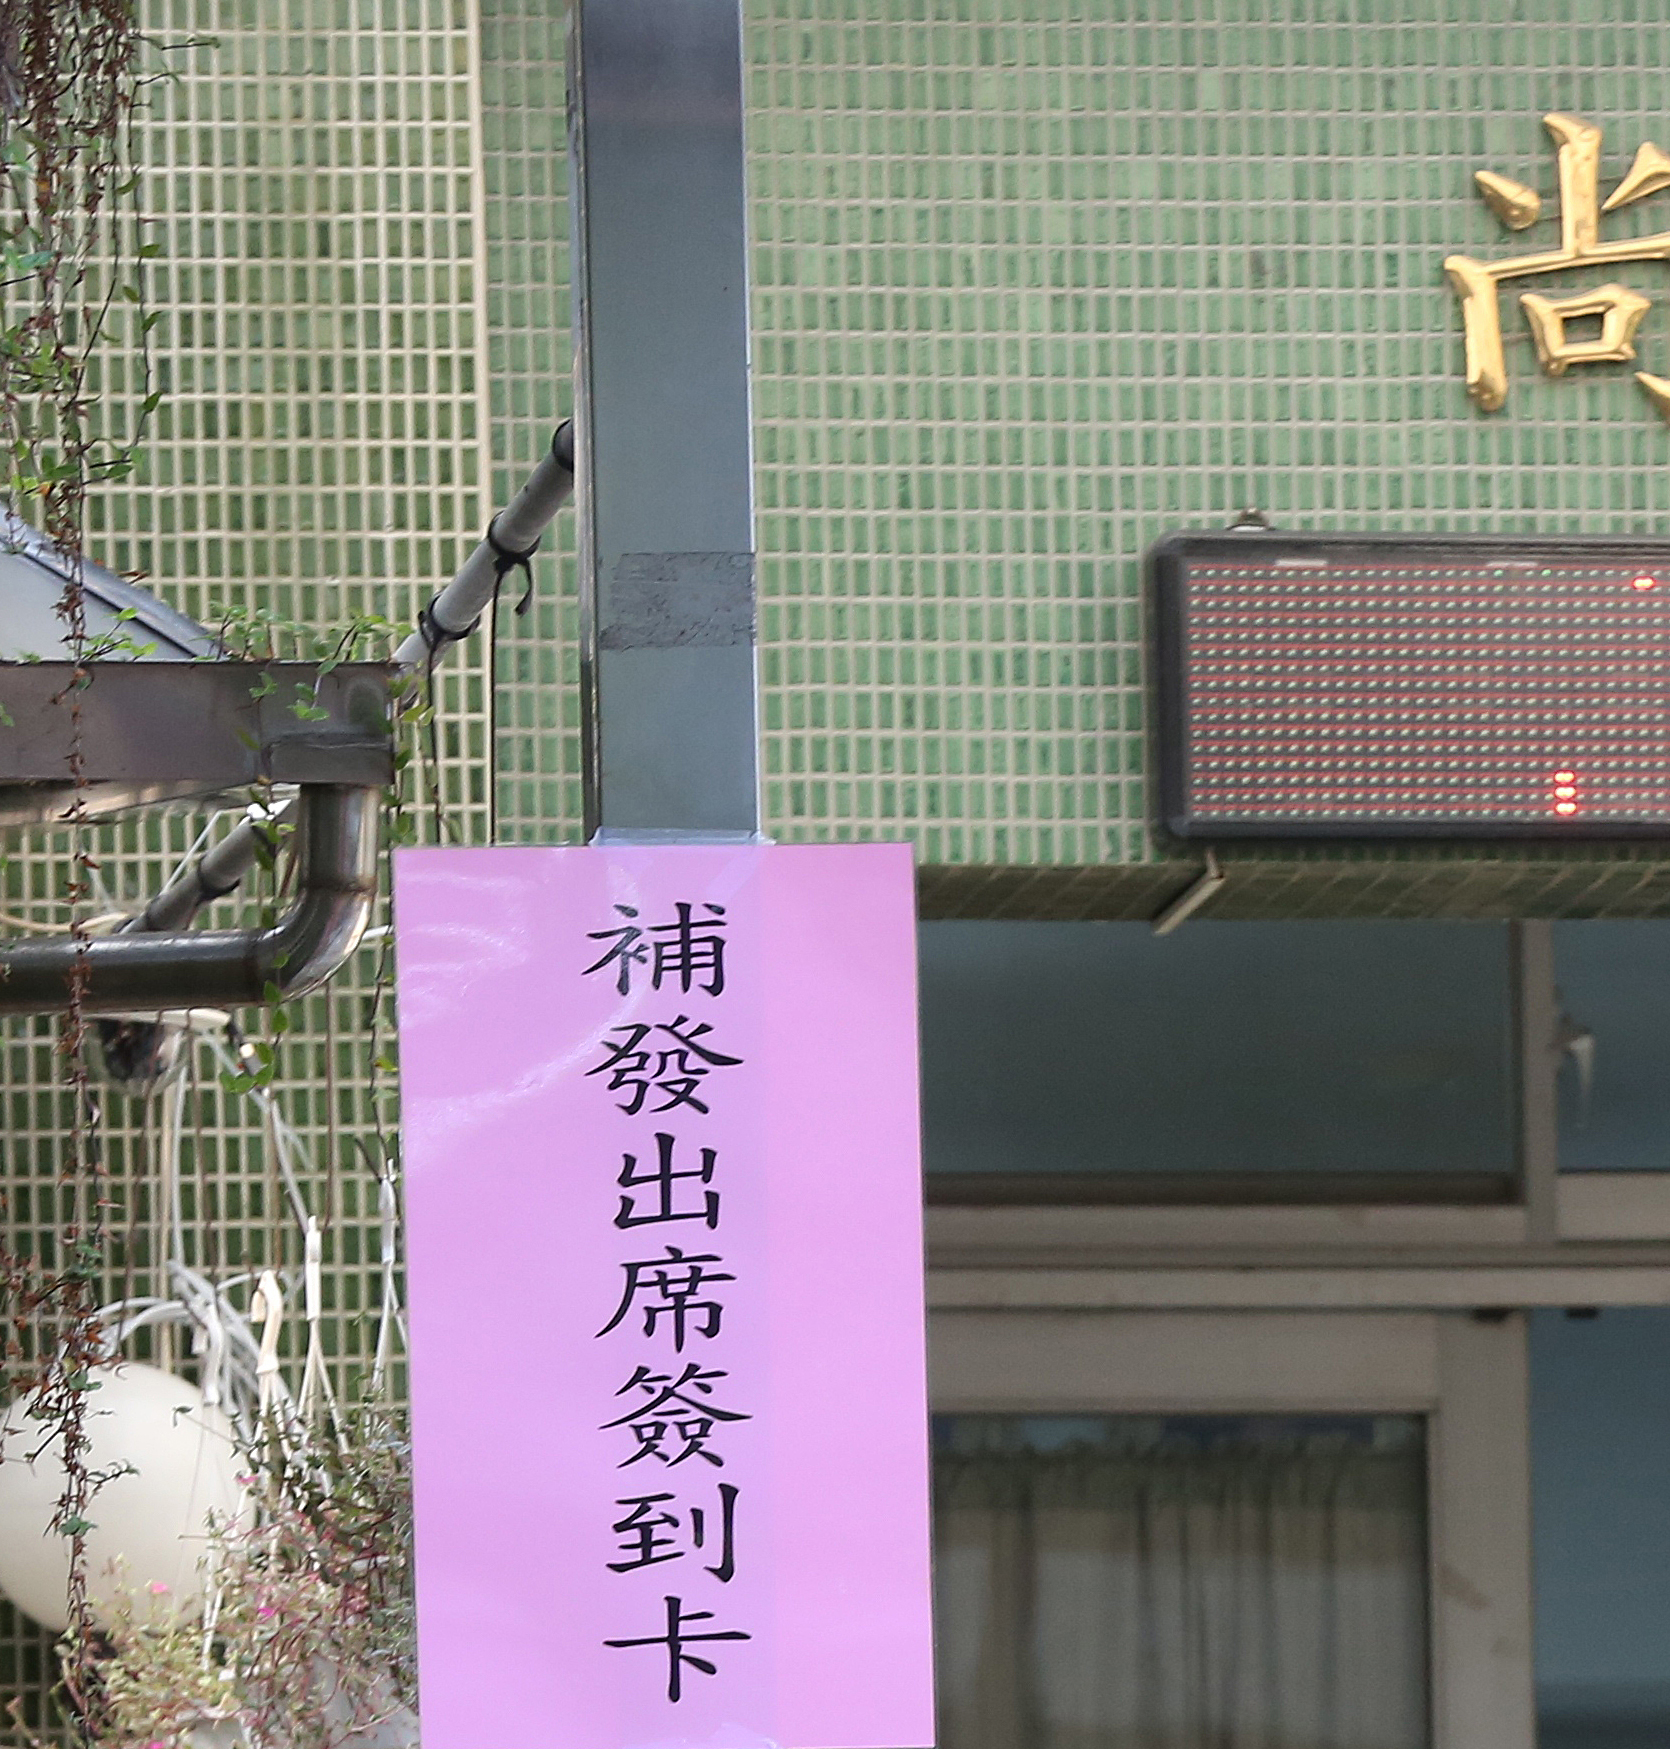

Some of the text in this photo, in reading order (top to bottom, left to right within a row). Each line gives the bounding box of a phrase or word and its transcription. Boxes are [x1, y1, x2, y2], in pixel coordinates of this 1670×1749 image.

[582, 902, 752, 1703] 補發出席簽到卡
